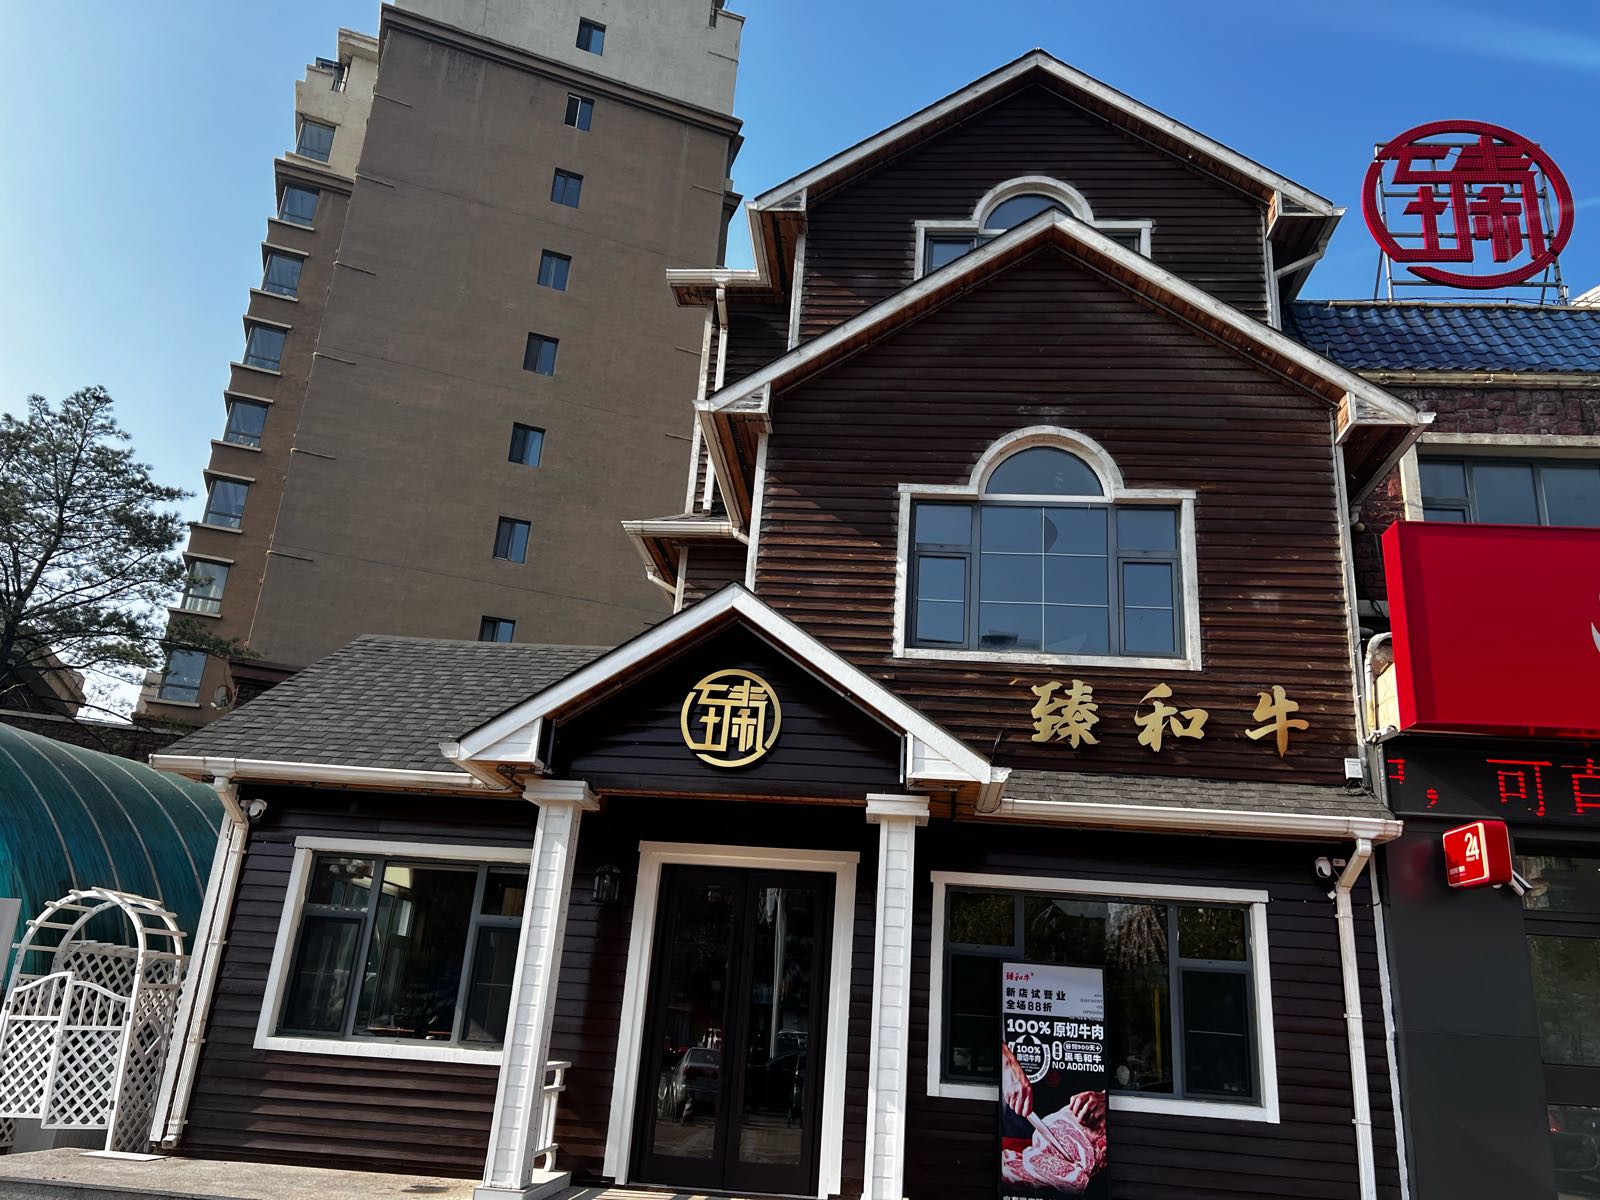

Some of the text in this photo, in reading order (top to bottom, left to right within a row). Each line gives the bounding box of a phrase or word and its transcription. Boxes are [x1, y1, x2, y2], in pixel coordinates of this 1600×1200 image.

[1031, 679, 1309, 758] 臻和牛
[1464, 832, 1480, 860] 24
[1006, 987, 1066, 1001] 新店试营业
[1006, 999, 1052, 1013] 全场88折
[1007, 1018, 1104, 1040] 100% 原切牛肉
[1016, 1045, 1041, 1054] 100%
[1052, 1061, 1105, 1073] NO ADDITION
